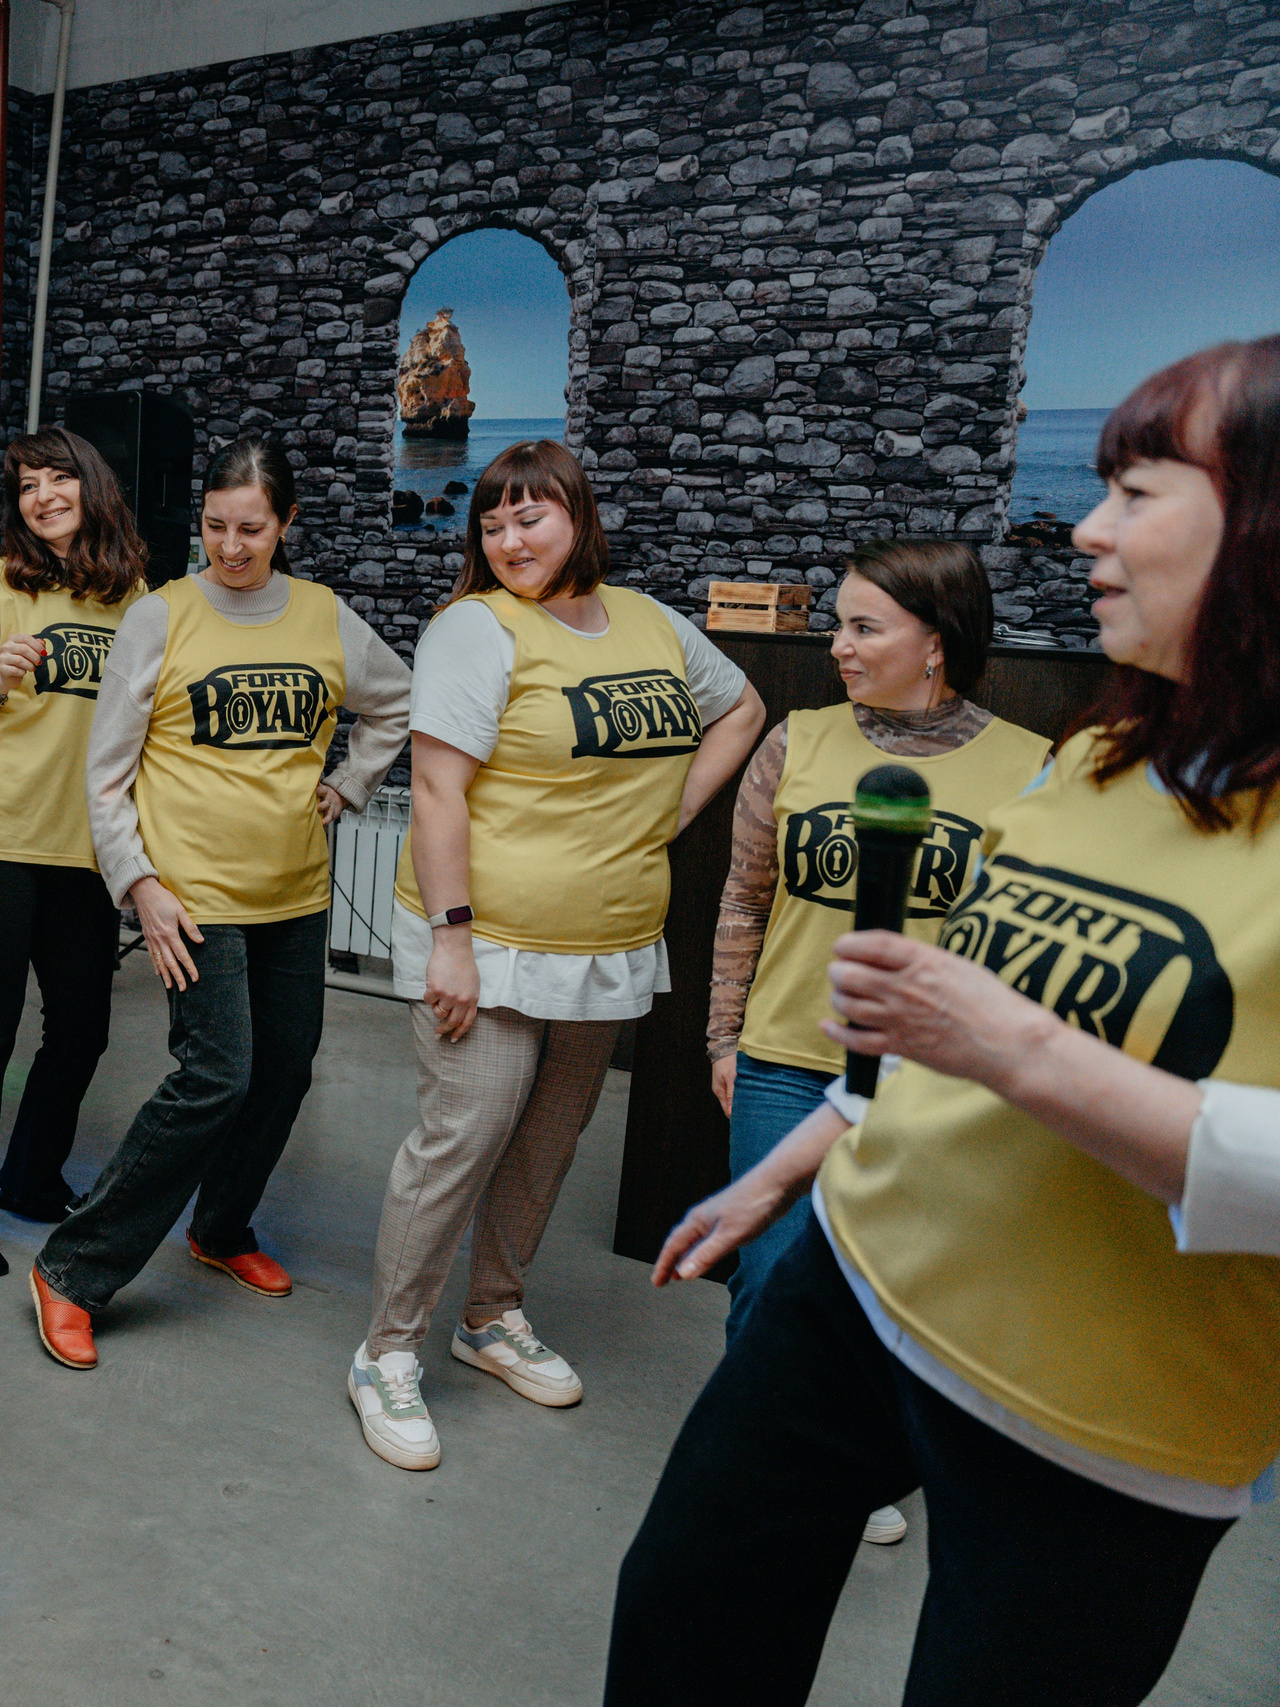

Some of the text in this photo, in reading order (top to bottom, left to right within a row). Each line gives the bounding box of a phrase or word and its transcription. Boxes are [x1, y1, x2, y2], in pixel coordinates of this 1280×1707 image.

[231, 673, 302, 689] FORT
[602, 679, 668, 698] FORT
[187, 674, 329, 745] BOYARD
[986, 881, 1143, 946] FORT
